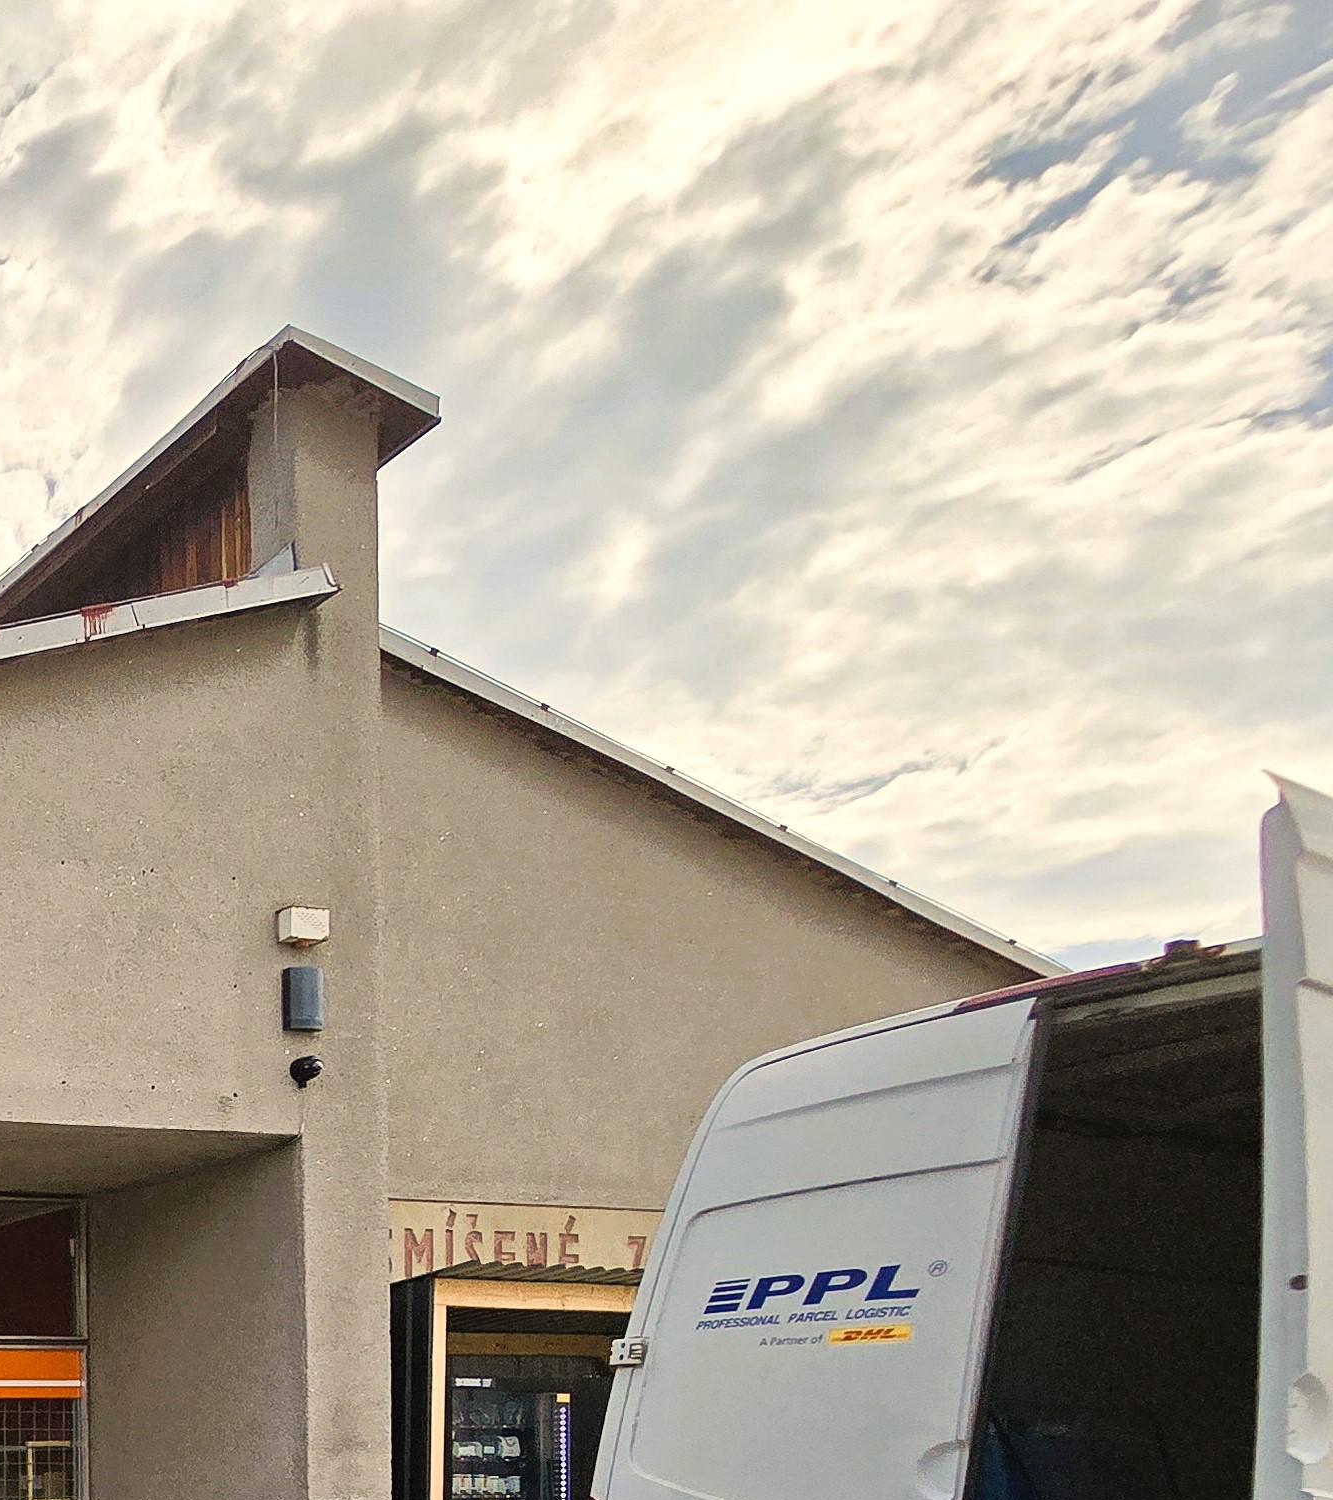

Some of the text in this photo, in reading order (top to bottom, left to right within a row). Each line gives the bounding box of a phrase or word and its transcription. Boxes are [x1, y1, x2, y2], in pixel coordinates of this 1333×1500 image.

[745, 1264, 921, 1310] PPL
[696, 1305, 913, 1331] PROFESSIONAL PARCEL LOGISTIC
[759, 1328, 898, 1347] A Partner of DHL
